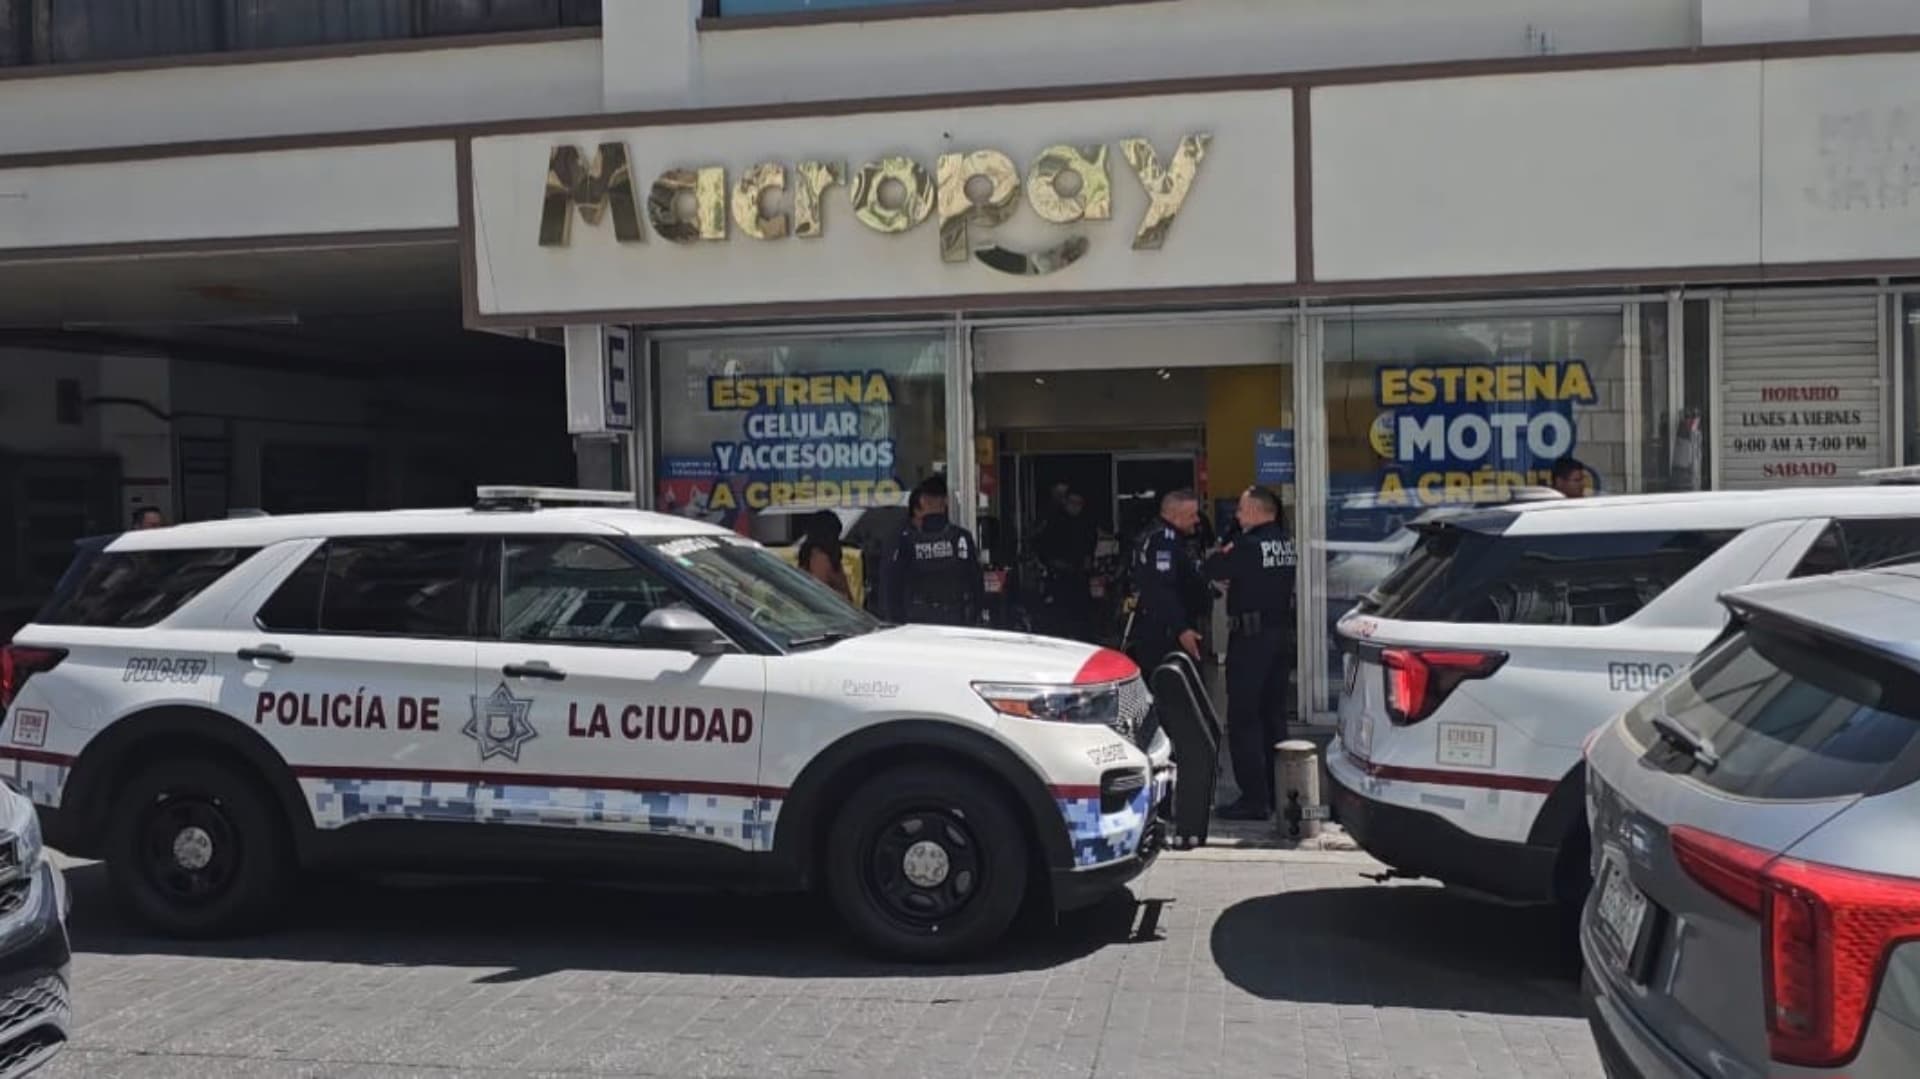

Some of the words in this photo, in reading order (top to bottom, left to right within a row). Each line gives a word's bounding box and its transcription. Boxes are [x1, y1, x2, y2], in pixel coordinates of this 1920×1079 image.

[538, 131, 1212, 272] Macropay
[711, 374, 892, 408] ESTRENA
[1380, 363, 1593, 405] ESTRENA
[1761, 386, 1840, 403] HORARIO
[748, 411, 860, 440] CELULAR
[1741, 411, 1785, 427] LUNES
[1790, 411, 1801, 426] A
[1801, 410, 1862, 426] VIERNES
[1398, 411, 1572, 462] MOTO
[1733, 438, 1766, 452] 9:00
[1771, 437, 1790, 451] AM
[1795, 437, 1803, 450] A
[1809, 437, 1841, 451] 7:00
[1846, 436, 1867, 450] PM
[716, 446, 736, 470] Y
[738, 442, 893, 471] ACCESORIOS
[1762, 462, 1837, 477] SABADO
[709, 482, 736, 509] A
[745, 475, 902, 509] CRÉDITO
[1378, 472, 1407, 505] A
[255, 686, 386, 729] POLICÍA
[397, 697, 440, 731] DE
[568, 703, 611, 739] LA
[620, 704, 753, 743] CIUDAD
